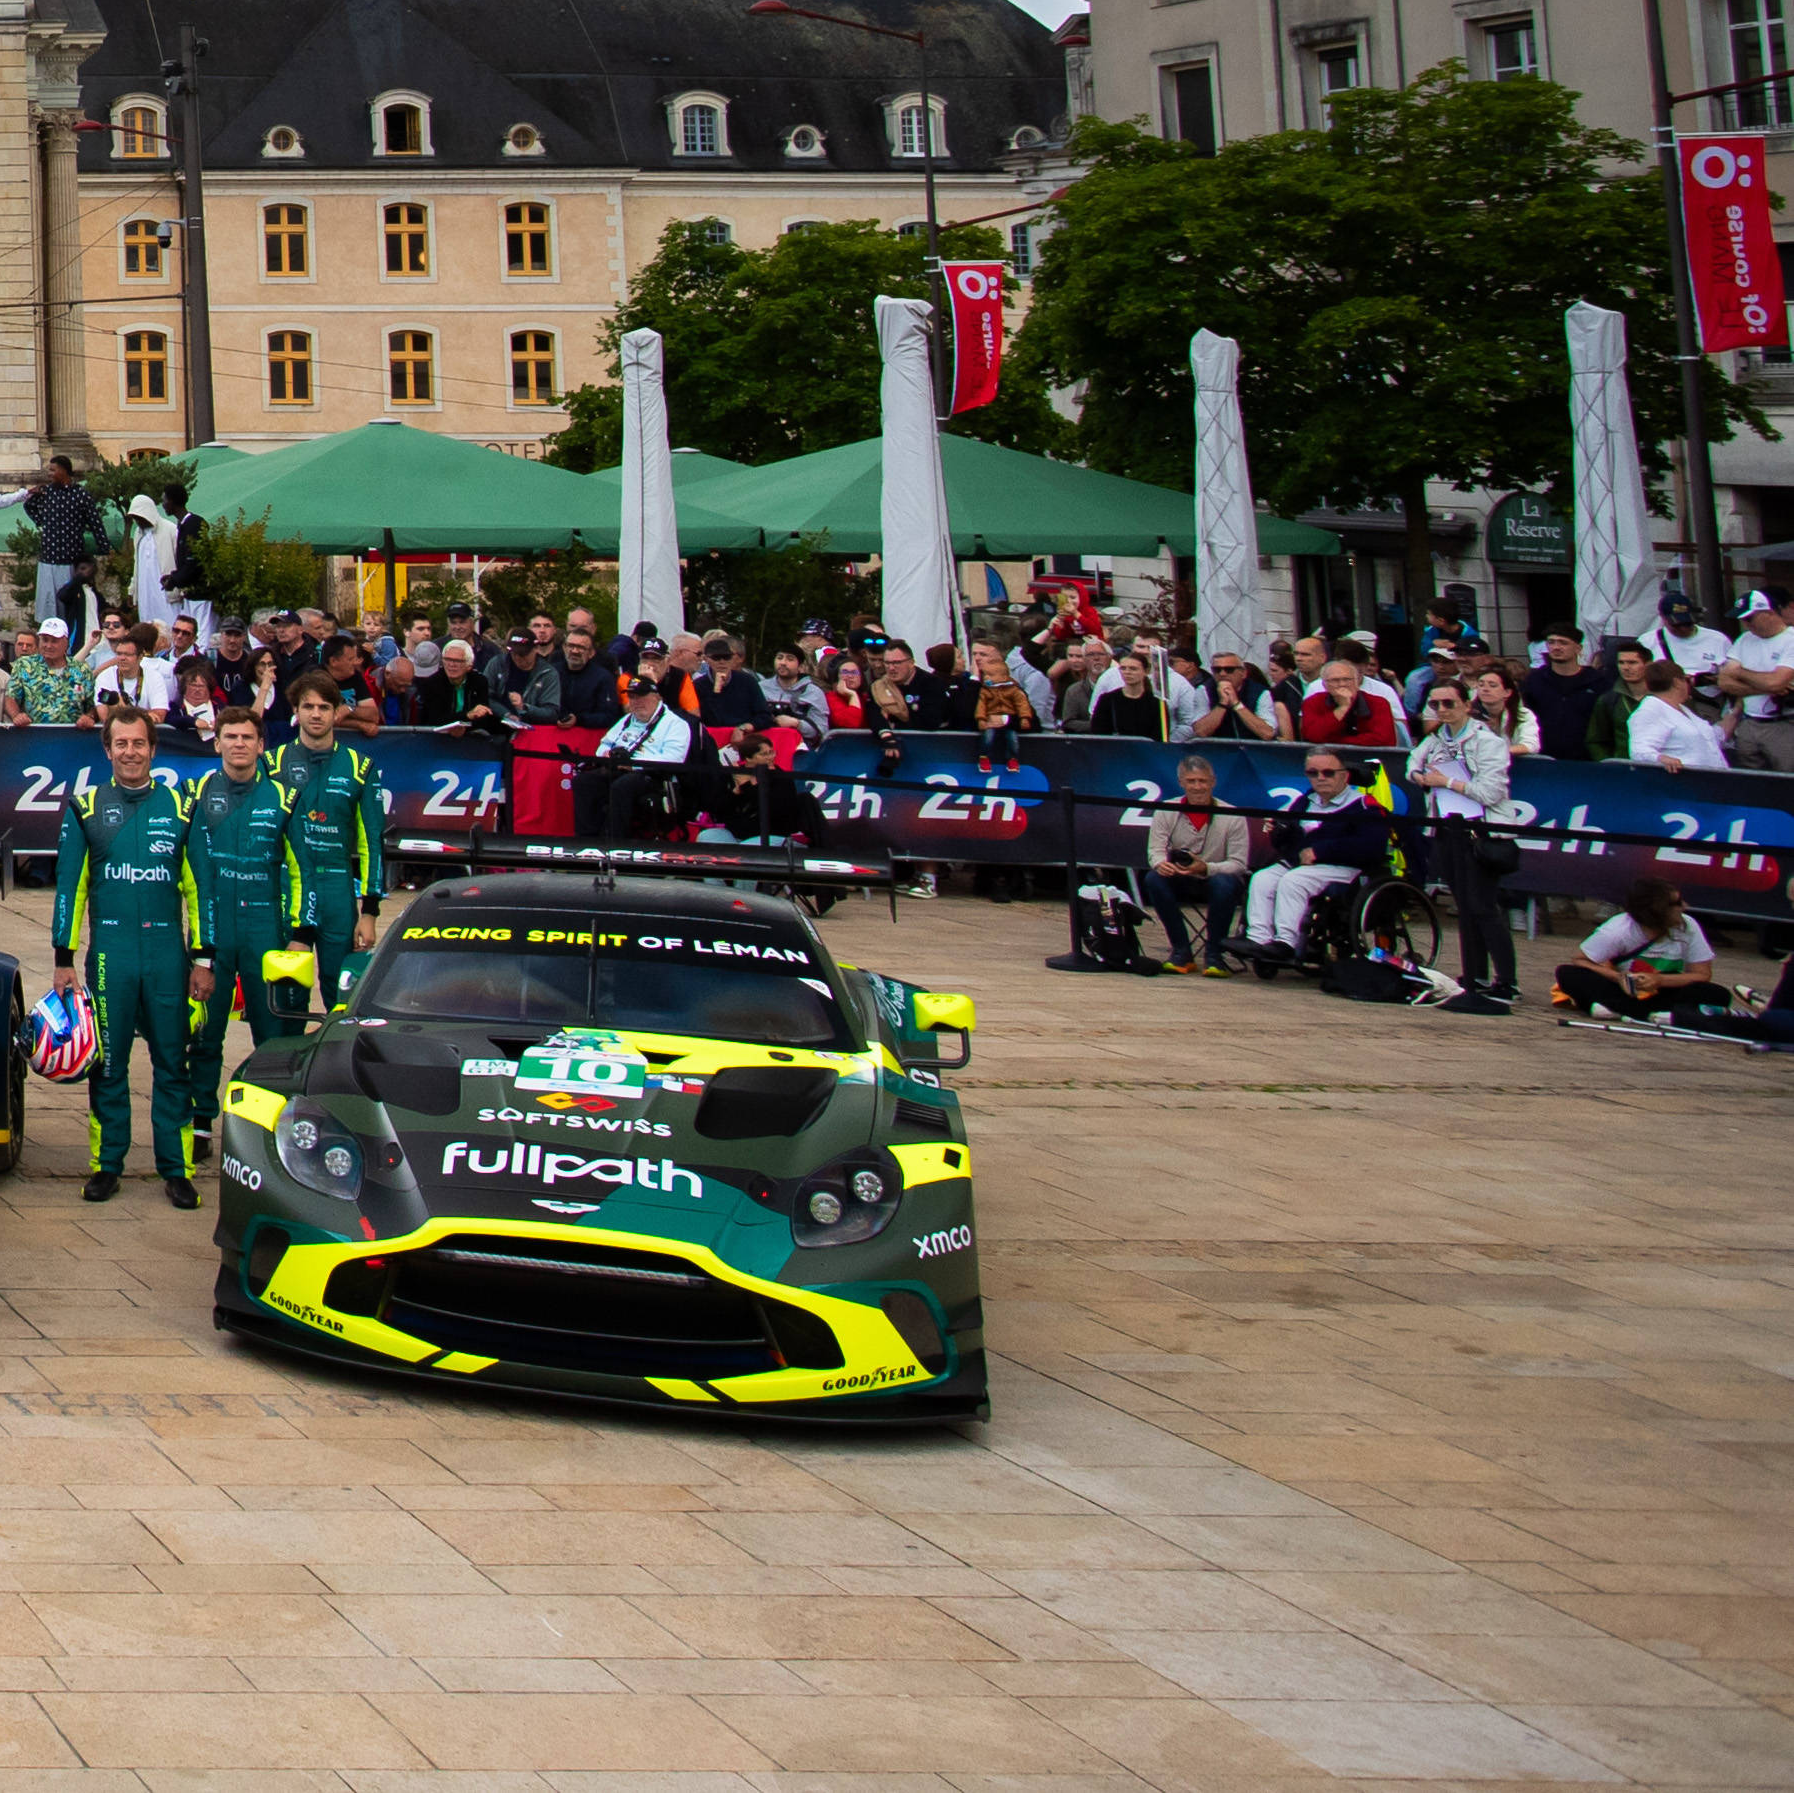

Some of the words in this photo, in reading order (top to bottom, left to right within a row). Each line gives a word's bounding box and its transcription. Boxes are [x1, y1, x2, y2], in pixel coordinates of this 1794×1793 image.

[1521, 498, 1541, 518] La
[1506, 517, 1562, 539] Réserve
[918, 775, 1017, 822] 24h
[104, 862, 171, 884] fullpath
[402, 927, 512, 943] RACING
[527, 929, 628, 947] SPIRIT
[638, 936, 684, 951] OF
[98, 953, 107, 991] RACING
[99, 996, 108, 1028] SPIRIT
[539, 1057, 628, 1084] 10
[477, 1107, 672, 1137] SOFTSWISS
[222, 1152, 262, 1191] xmco
[442, 1142, 703, 1198] fullpath
[913, 1224, 972, 1259] xmco
[270, 1291, 344, 1334] GOODYEAR
[822, 1364, 916, 1391] GOODYEAR
